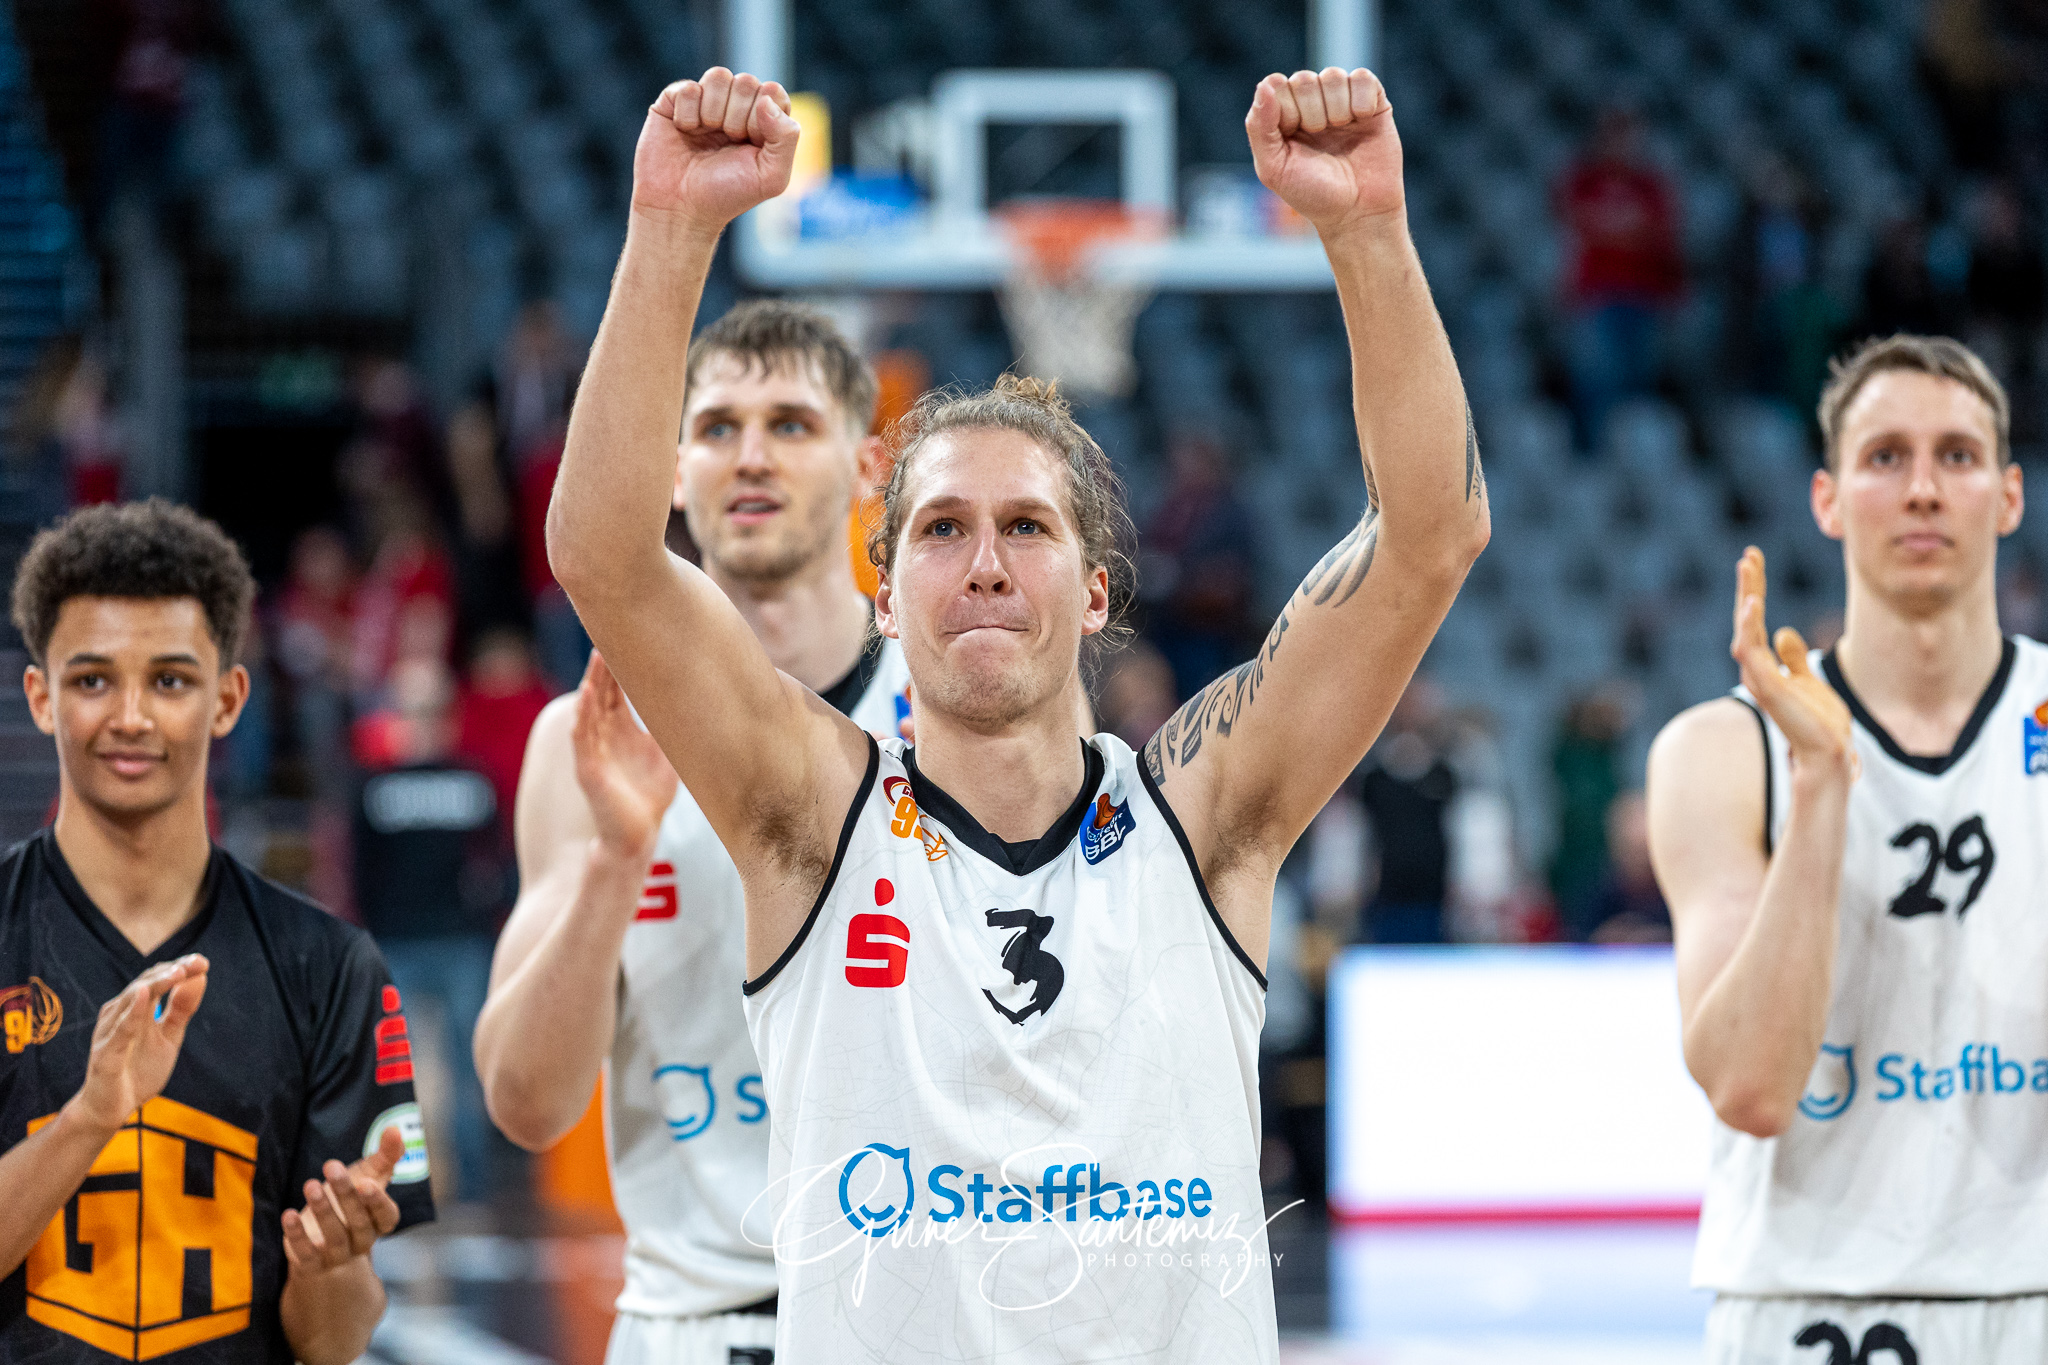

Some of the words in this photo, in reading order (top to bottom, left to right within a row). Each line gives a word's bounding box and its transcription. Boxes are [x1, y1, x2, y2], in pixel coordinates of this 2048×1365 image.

[1084, 821, 1126, 860] BBL
[1888, 815, 1994, 920] 29
[981, 909, 1065, 1026] 3
[1875, 1043, 2048, 1102] Staffba
[927, 1163, 1213, 1223] Staffbase
